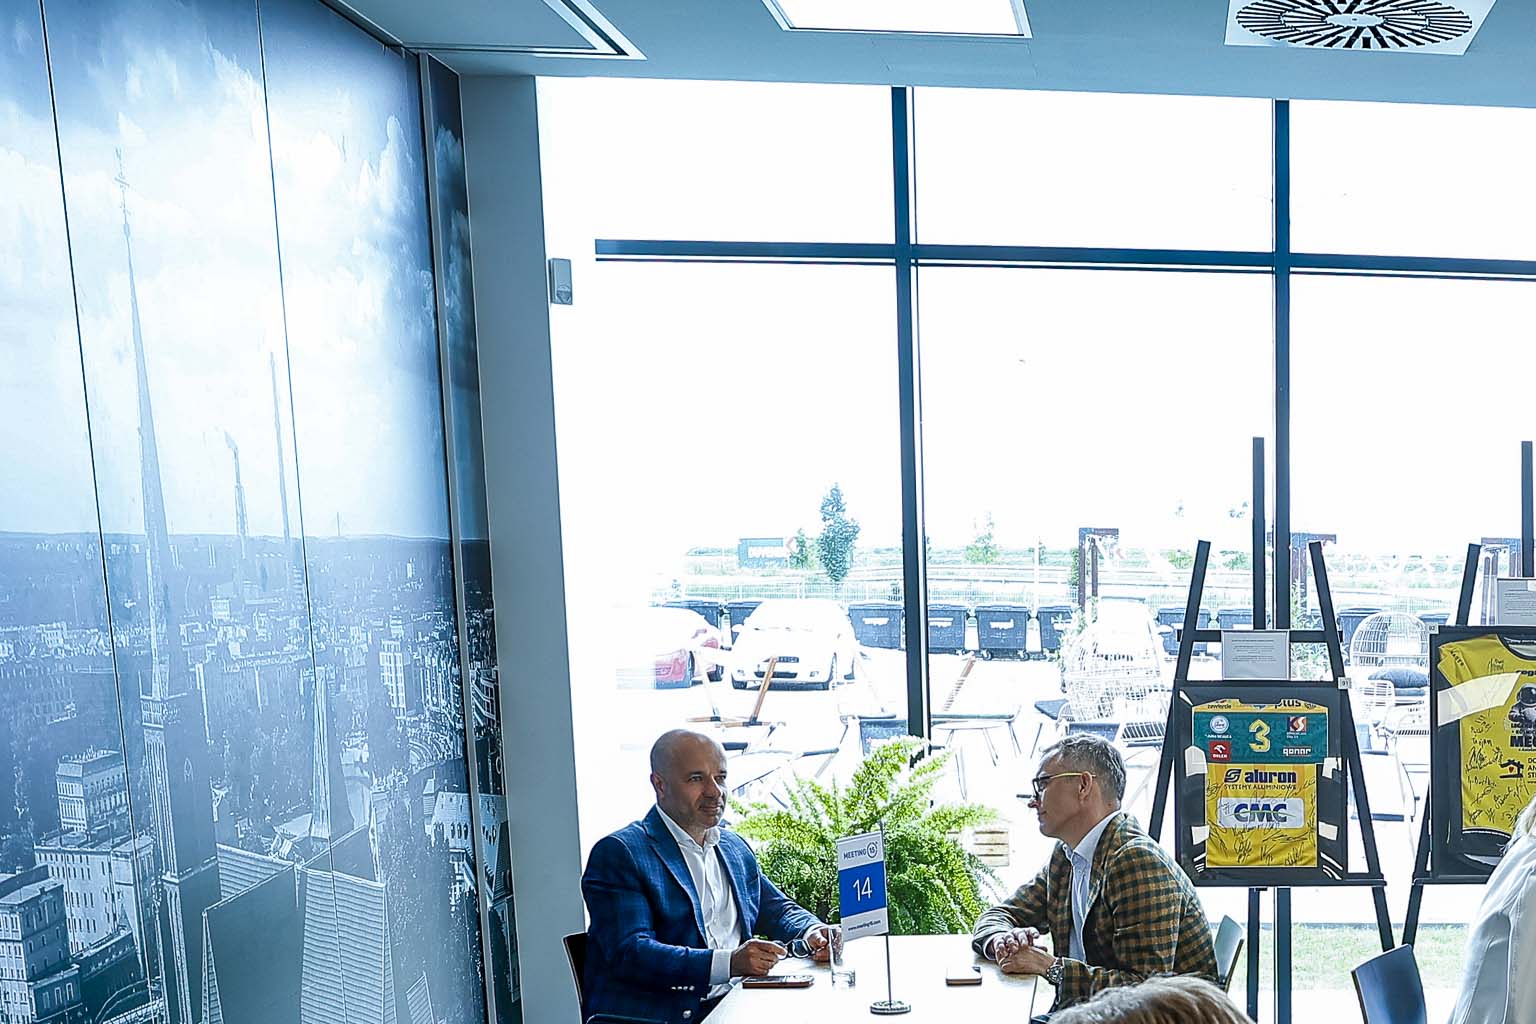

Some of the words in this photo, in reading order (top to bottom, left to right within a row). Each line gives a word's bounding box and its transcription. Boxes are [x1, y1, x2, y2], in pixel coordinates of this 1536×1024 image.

[1248, 719, 1271, 752] 3
[1244, 769, 1297, 783] aluron
[1233, 803, 1287, 822] CMC
[843, 849, 867, 860] MEETING
[852, 876, 873, 902] 14
